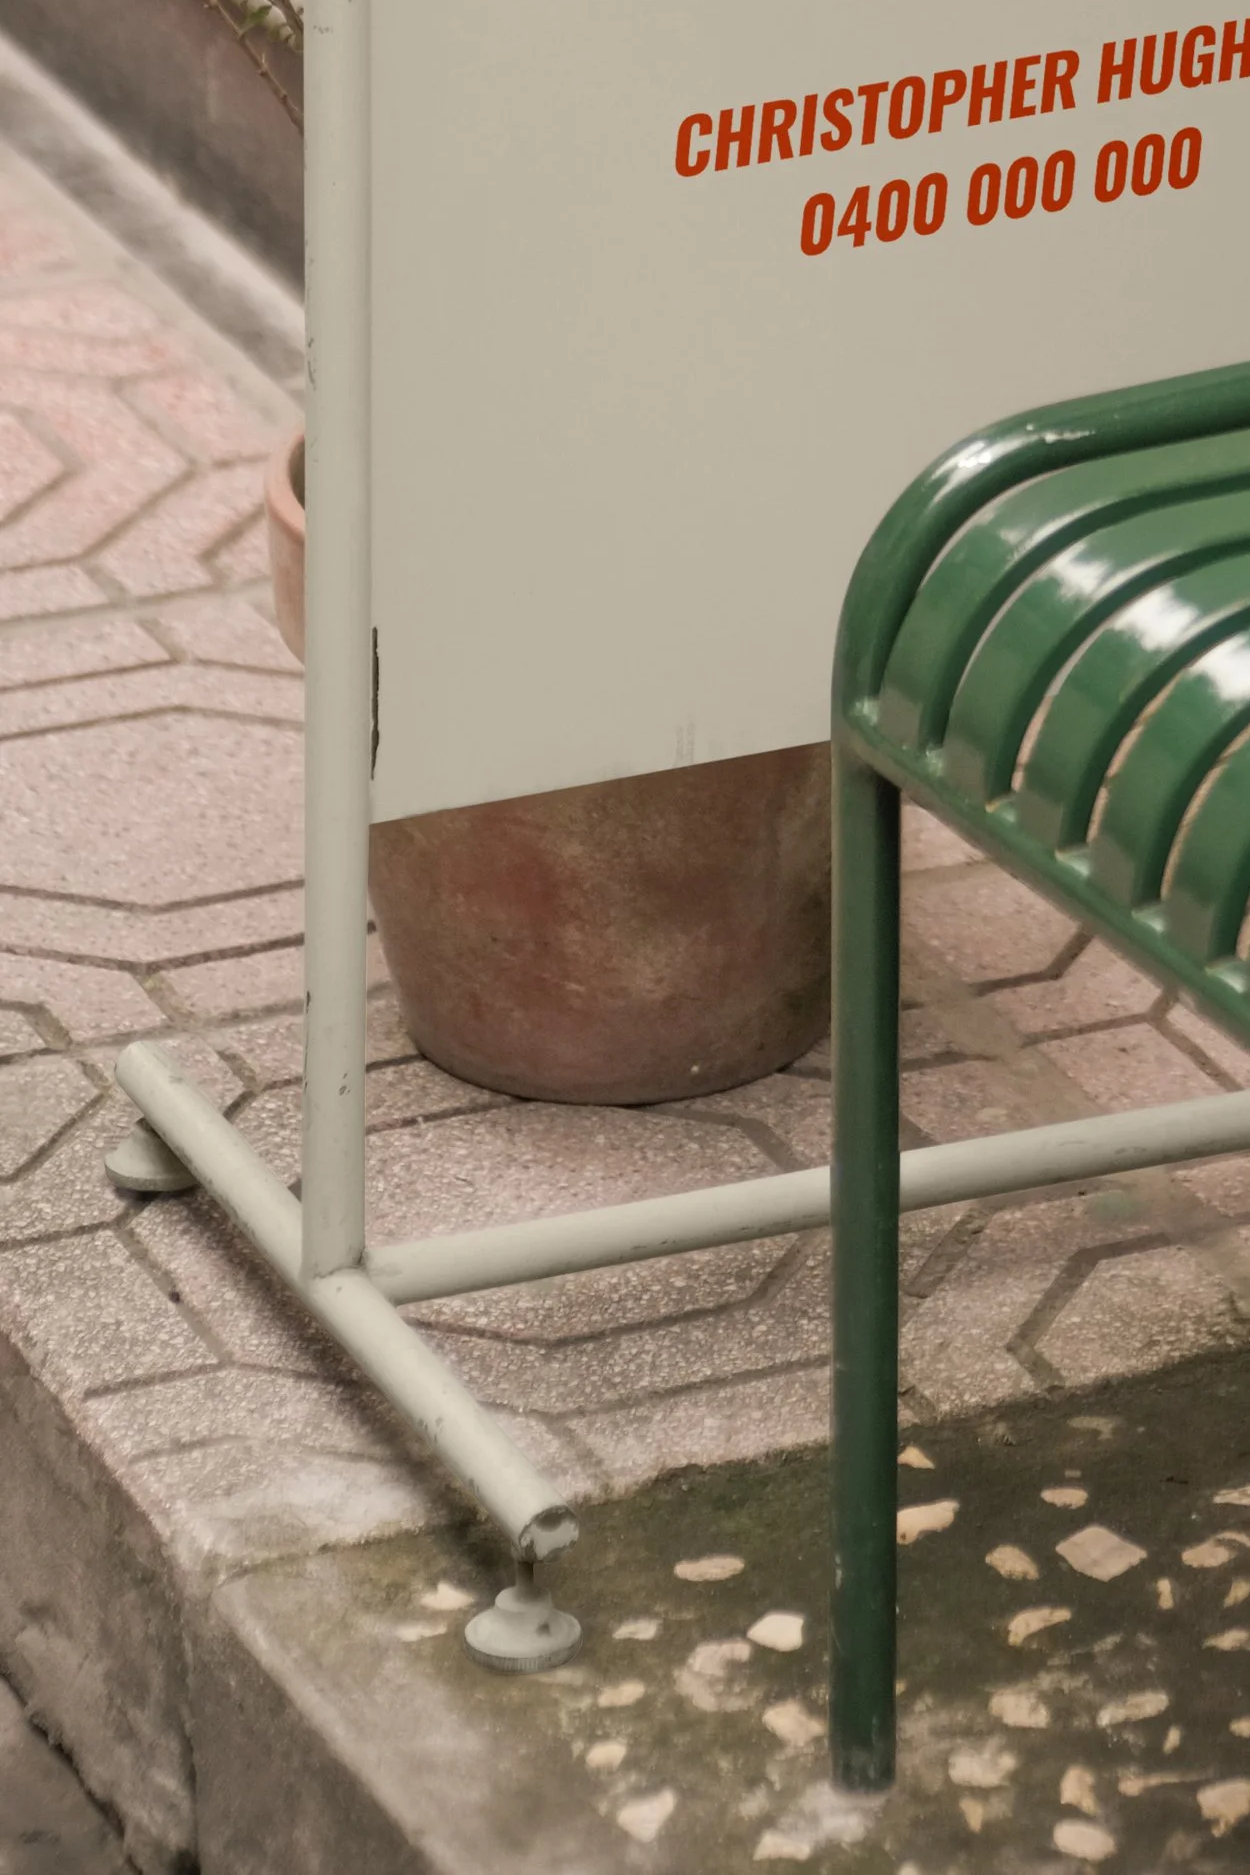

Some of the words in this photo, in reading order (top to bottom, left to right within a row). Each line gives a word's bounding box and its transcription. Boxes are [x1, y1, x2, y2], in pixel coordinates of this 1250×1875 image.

[675, 49, 1080, 178] CHRISTOPHER
[799, 172, 949, 257] 0400
[966, 149, 1076, 227] 000
[1093, 126, 1203, 204] 000
